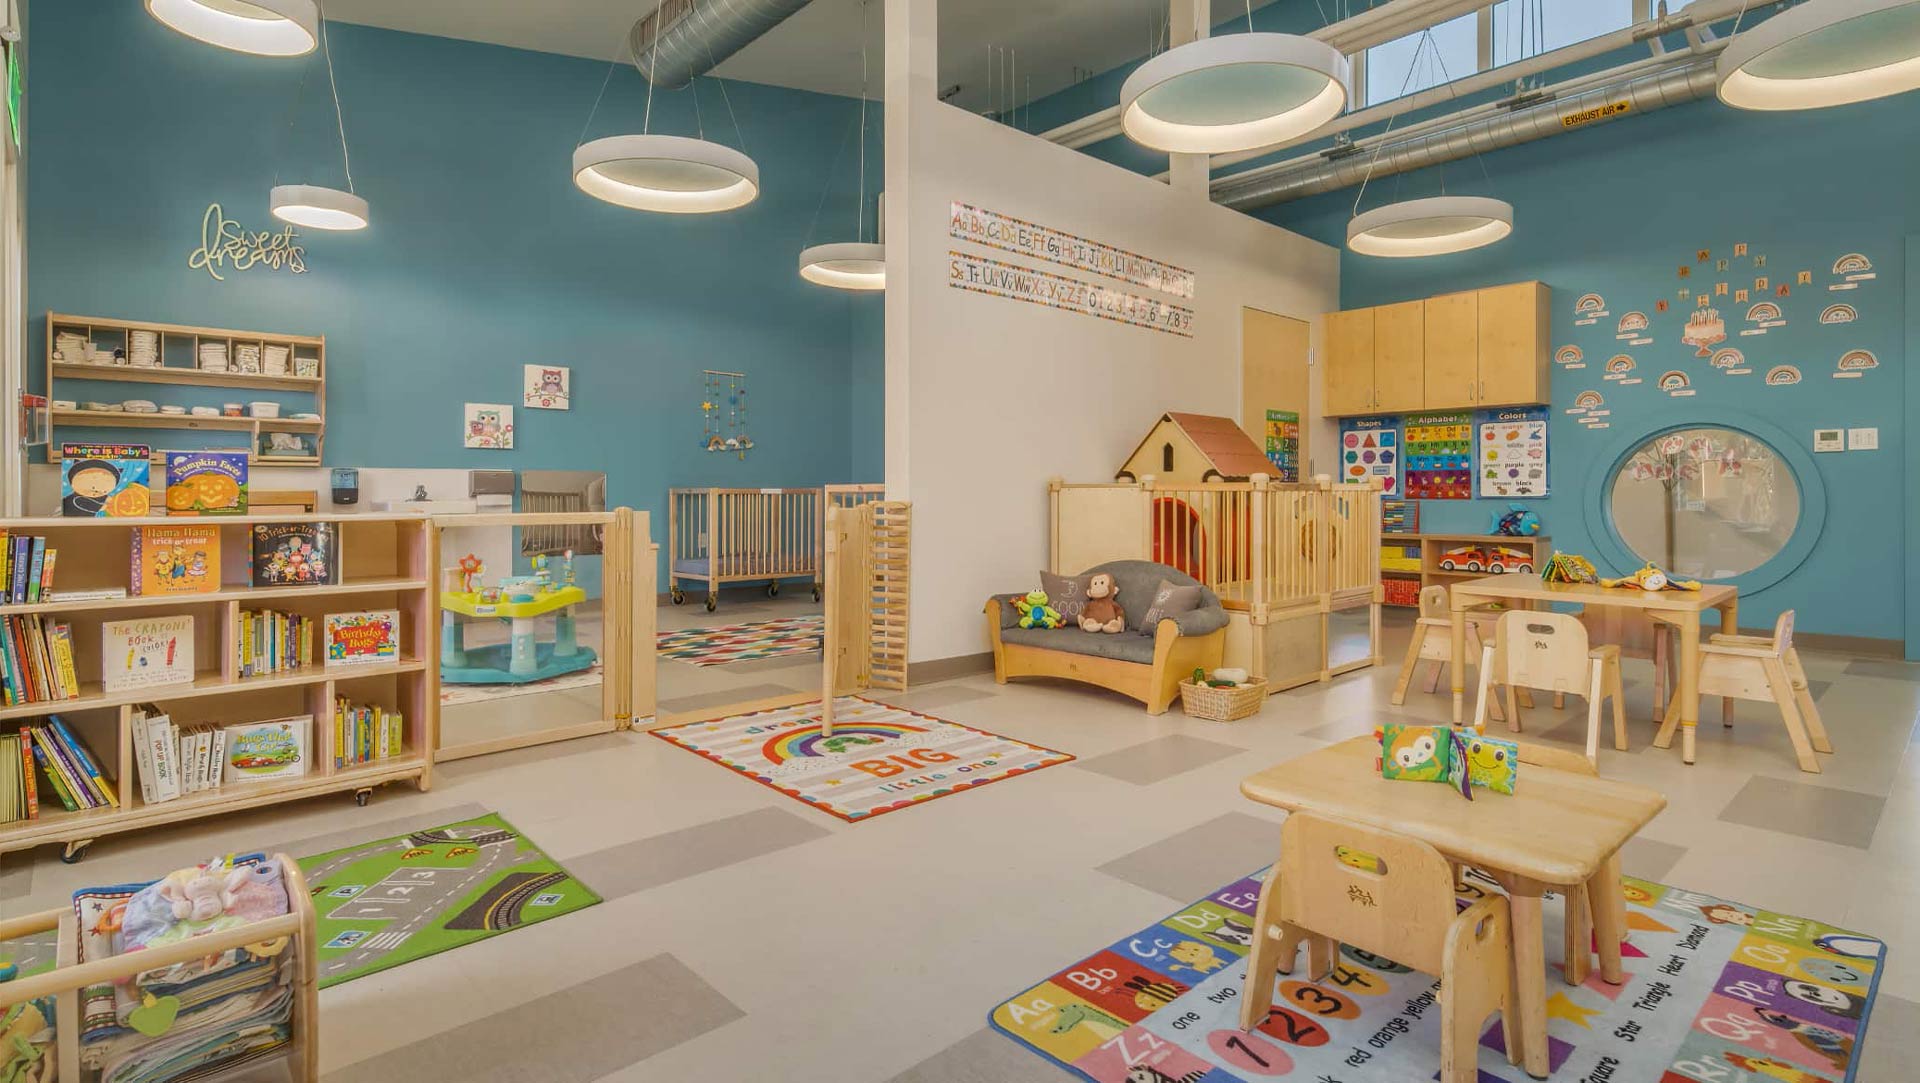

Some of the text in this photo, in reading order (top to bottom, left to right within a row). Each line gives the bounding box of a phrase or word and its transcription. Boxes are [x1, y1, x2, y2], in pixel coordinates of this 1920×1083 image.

[1565, 105, 1615, 126] EXHAUST AIR
[188, 203, 308, 280] dreams
[221, 220, 299, 250] Sweet
[952, 211, 967, 231] Aa
[971, 214, 985, 236] Bb
[987, 221, 1000, 240] Cc
[1001, 222, 1016, 244] Dd
[1018, 229, 1032, 248] Ee
[1033, 232, 1046, 252] Ff
[1047, 236, 1060, 257] Gg
[1089, 248, 1099, 268] Jj
[1101, 251, 1114, 269] Kk
[951, 260, 963, 280] Ss
[966, 263, 979, 283] Tt
[983, 266, 998, 287] Uu
[1000, 271, 1013, 290] Vv
[1014, 273, 1030, 294] Ww
[1032, 278, 1045, 296] Xx
[1048, 281, 1062, 301] Yy
[1089, 292, 1097, 308] 0
[1150, 306, 1156, 322] 6
[1174, 312, 1180, 328] 8
[1418, 415, 1458, 424] Alphabet
[1498, 412, 1527, 420] Colors
[64, 446, 100, 456] Where
[101, 446, 113, 455] is
[114, 446, 149, 458] Baby's
[1504, 461, 1524, 469] purple
[173, 458, 217, 476] Pumpkin
[152, 536, 174, 545] trick
[340, 627, 381, 640] Birthday
[848, 748, 960, 778] BIG
[878, 760, 998, 792] little one
[387, 886, 415, 895] 2
[1173, 908, 1221, 929] Dd
[1755, 916, 1802, 939] Nn
[1129, 938, 1174, 958] Cc
[1743, 943, 1790, 964] Oo
[1066, 967, 1118, 991] Bb
[1331, 966, 1372, 988] 4
[1007, 998, 1055, 1025] Aa
[1172, 987, 1237, 1031] one two
[1295, 986, 1343, 1015] 3
[1579, 923, 1711, 1083] quare Star Triangle Heart Diamond
[1264, 1009, 1317, 1043] 2
[1344, 987, 1436, 1068] red orange yellow
[1700, 1012, 1768, 1042] Qq
[1100, 1031, 1165, 1066] Zz
[1226, 1035, 1270, 1068] 1
[1673, 1054, 1731, 1083] Rr
